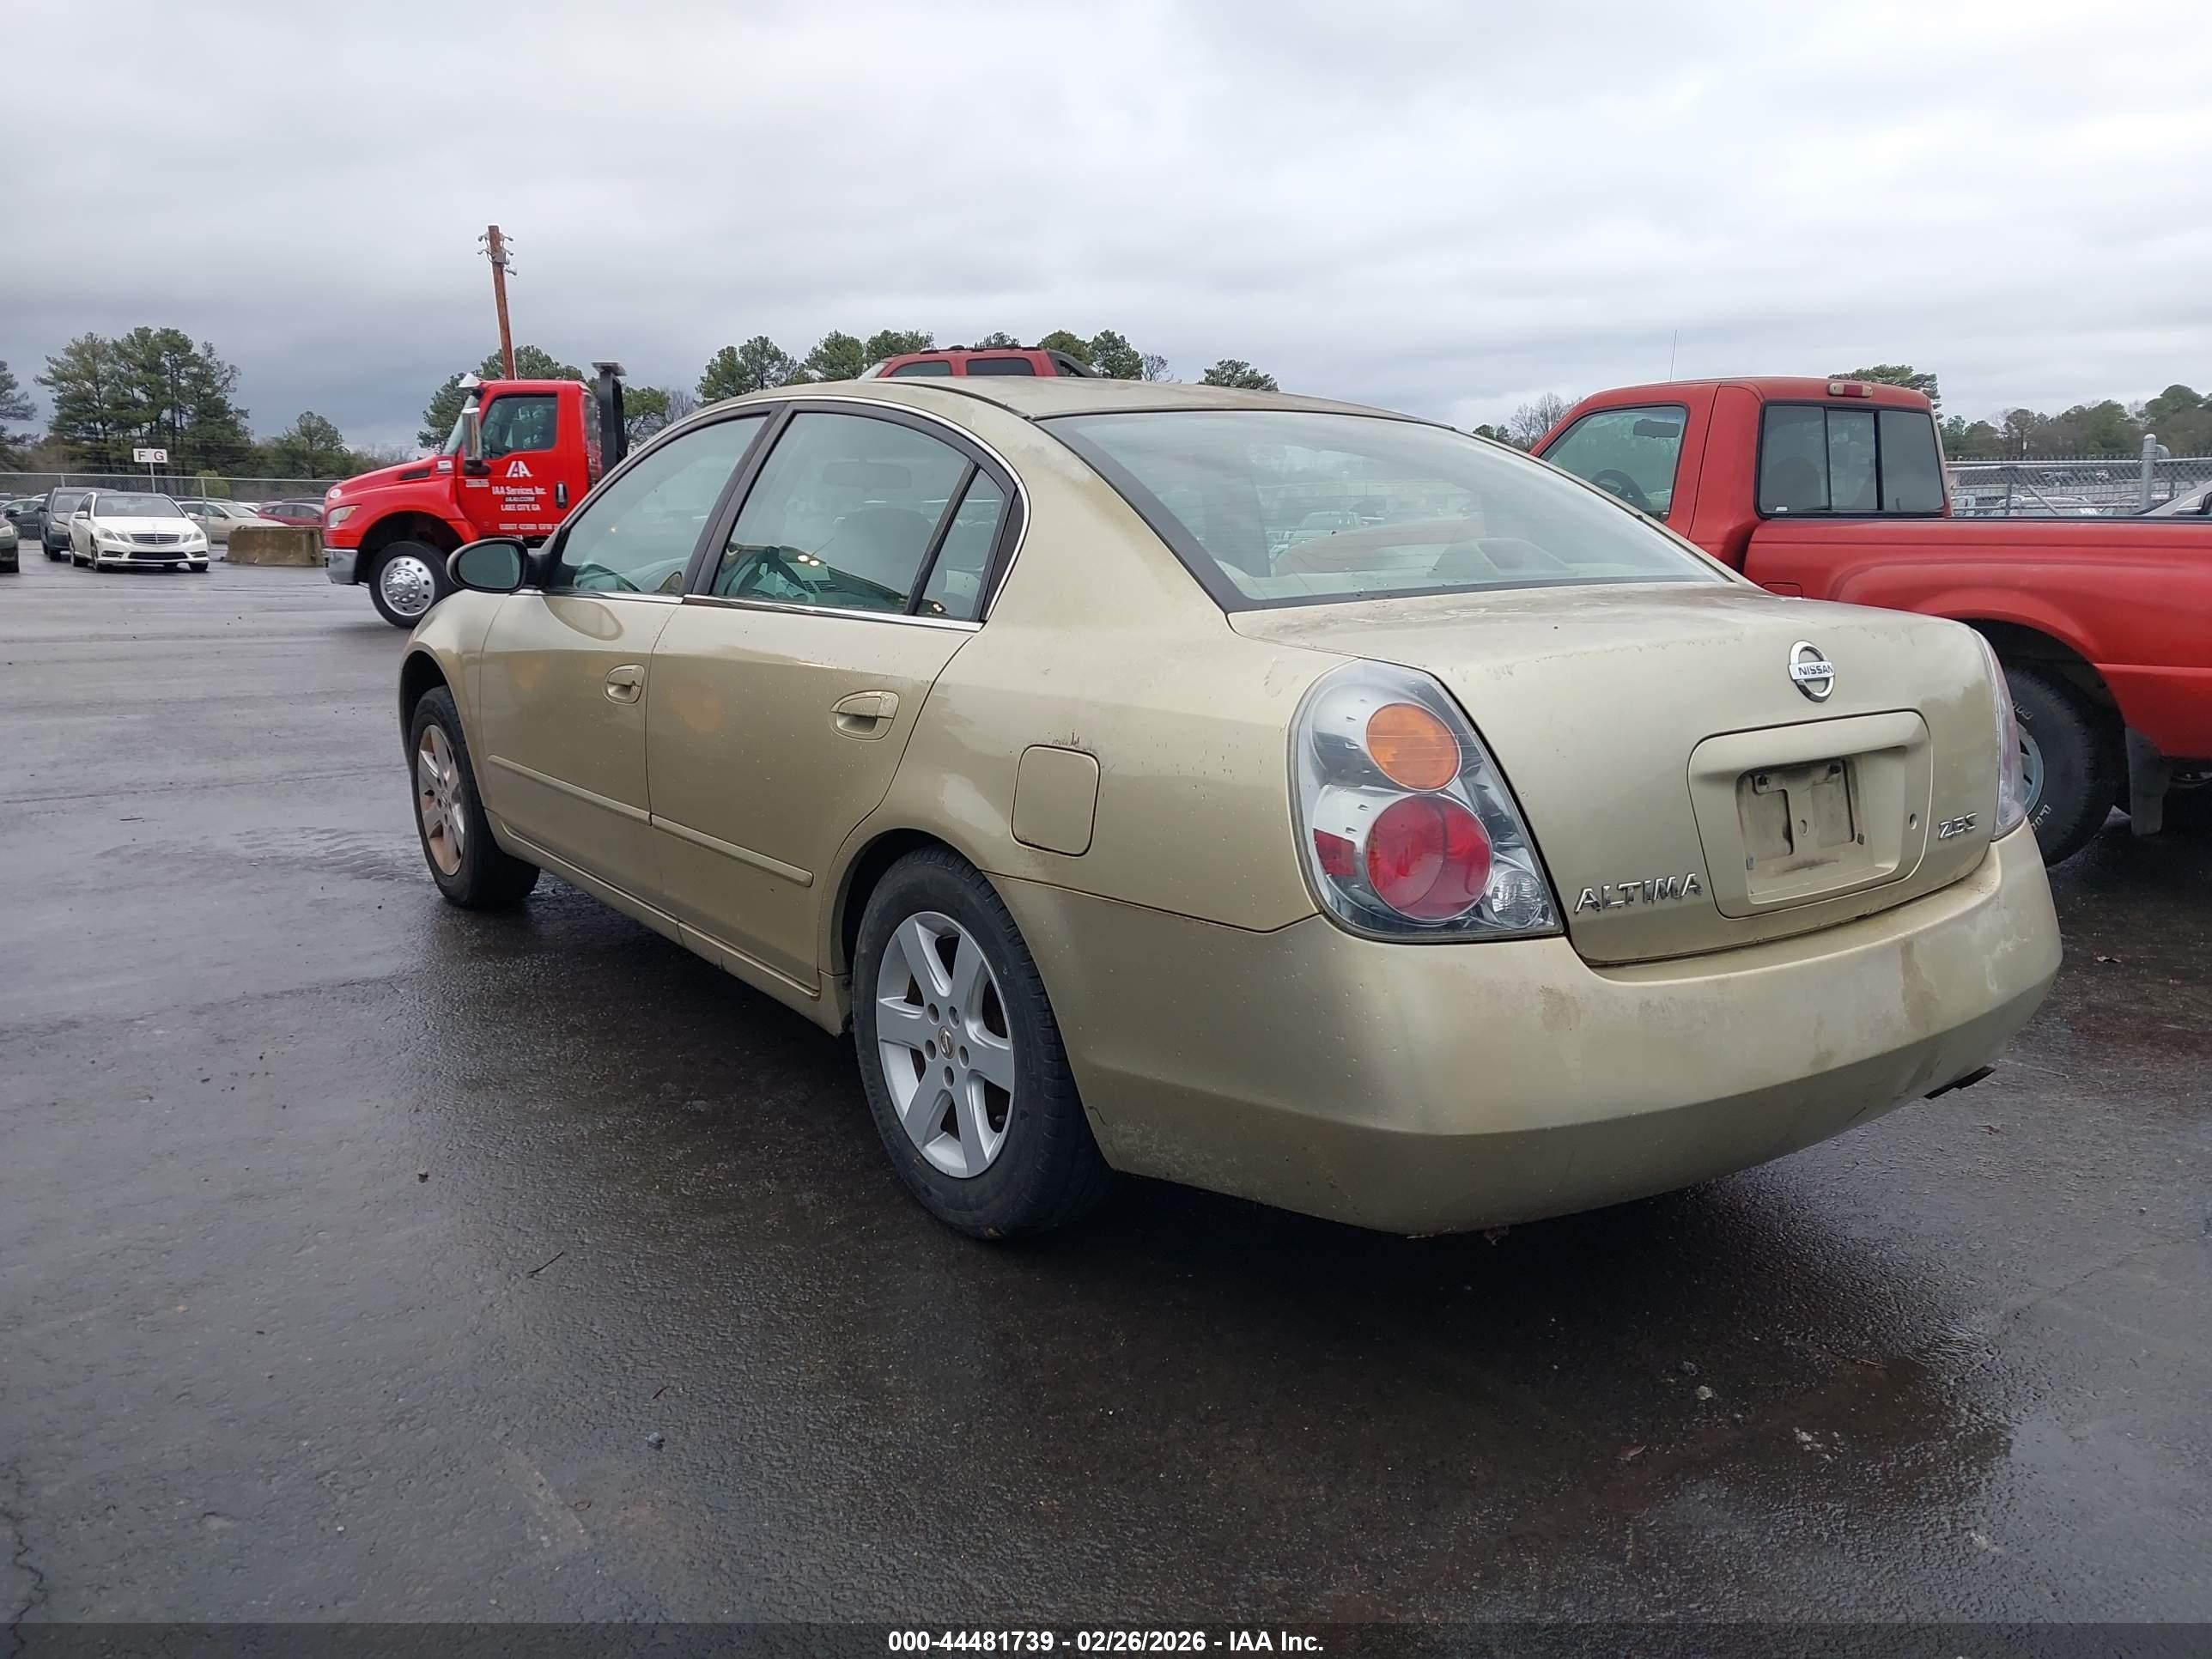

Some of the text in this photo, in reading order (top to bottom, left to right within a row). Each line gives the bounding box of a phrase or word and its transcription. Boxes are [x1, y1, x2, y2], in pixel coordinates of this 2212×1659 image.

[138, 450, 165, 461] F G
[1798, 665, 1834, 676] NISSAN
[1574, 873, 1703, 915] ALTIMA
